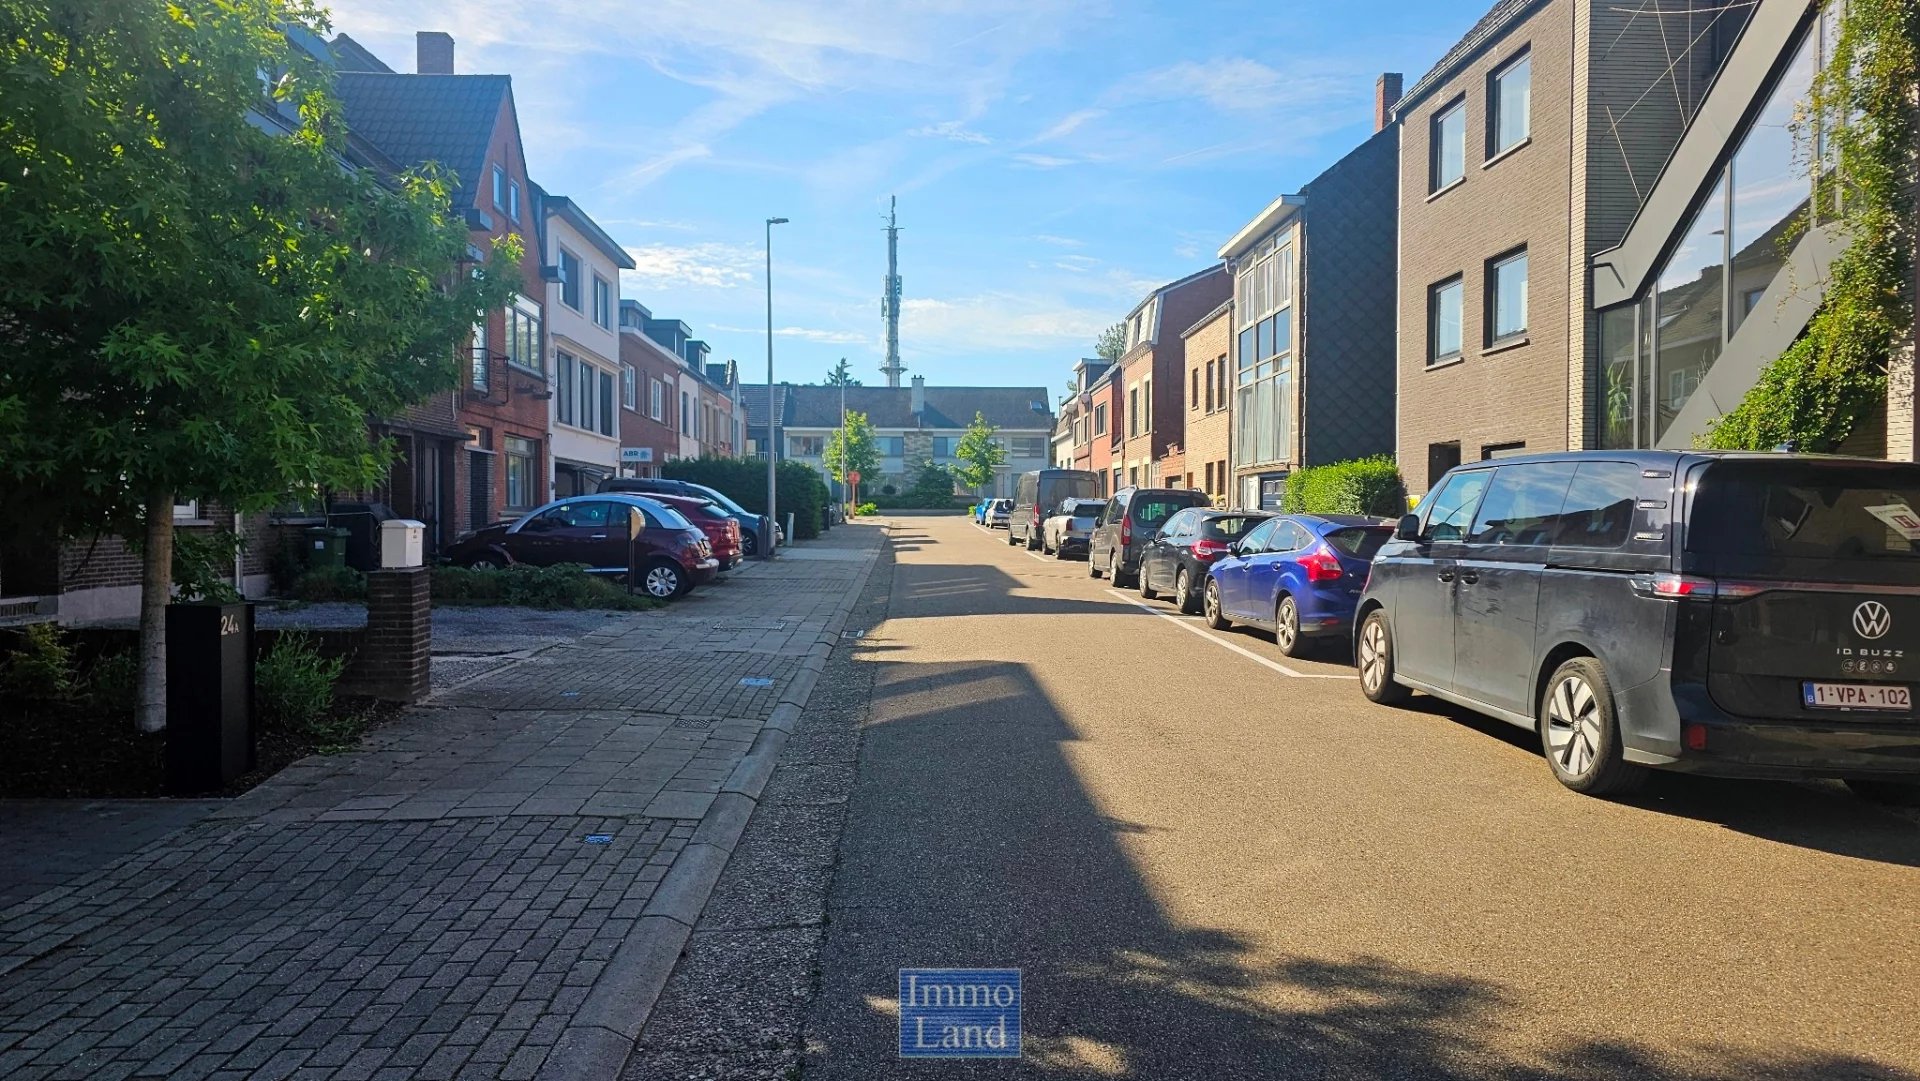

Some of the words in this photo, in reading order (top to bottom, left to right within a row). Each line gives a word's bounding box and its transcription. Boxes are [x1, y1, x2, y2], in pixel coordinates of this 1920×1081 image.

[221, 614, 240, 635] 24A
[1860, 649, 1904, 657] BUZZ
[1807, 695, 1814, 703] B
